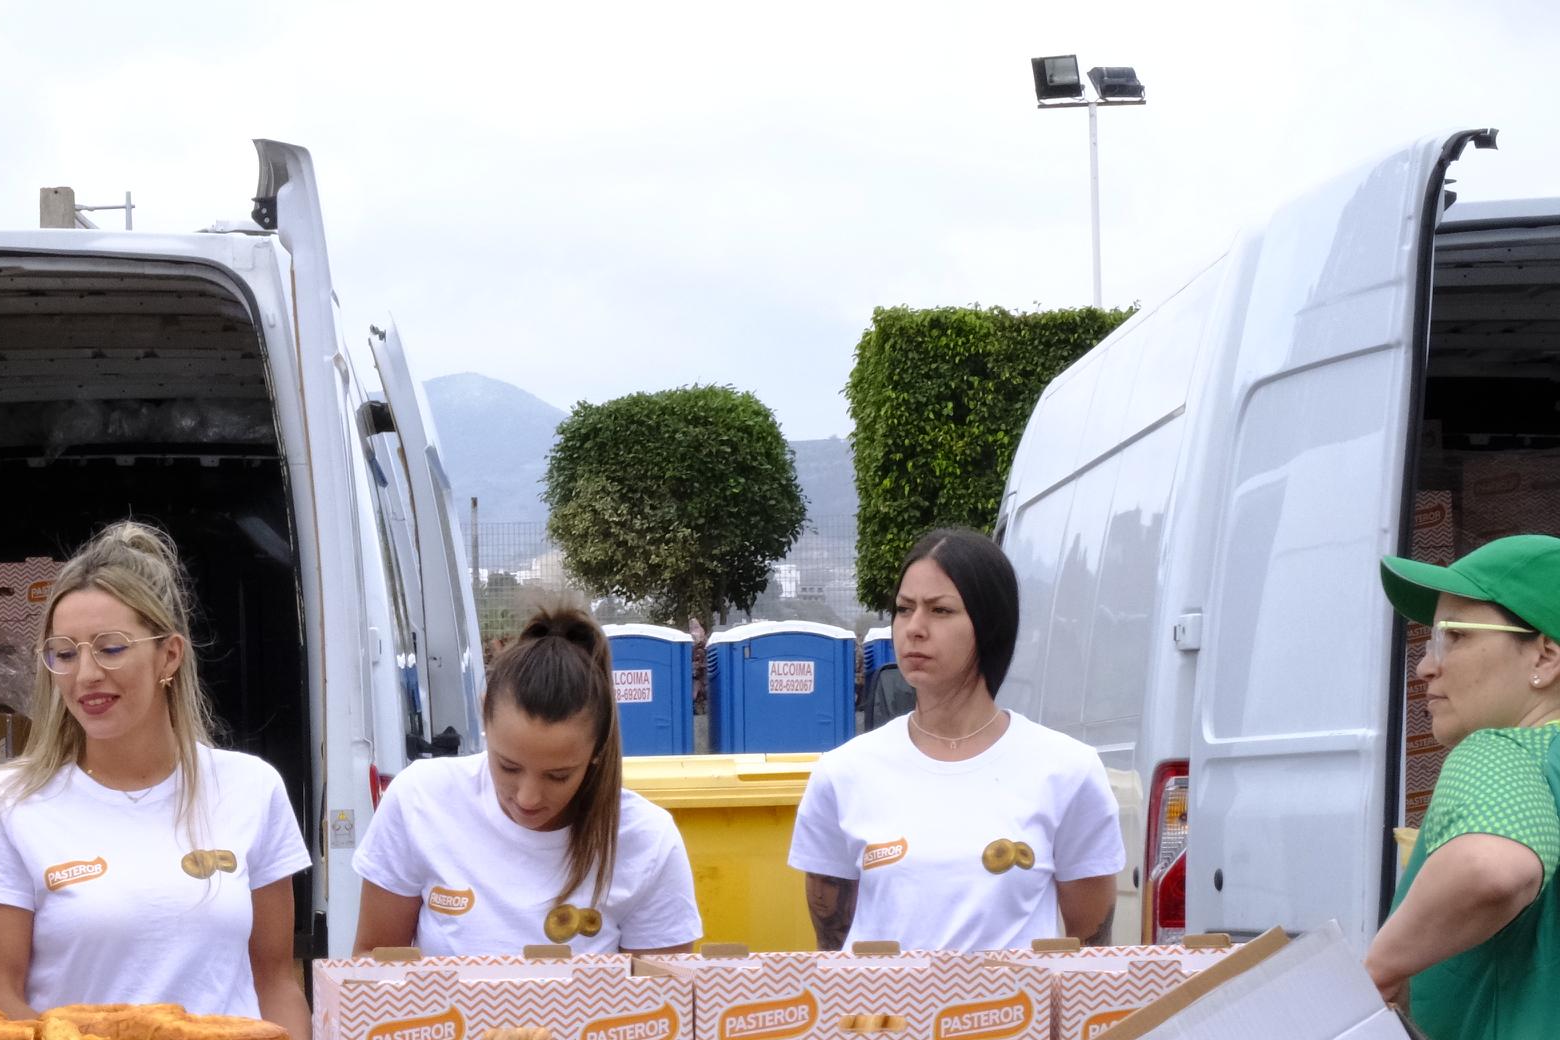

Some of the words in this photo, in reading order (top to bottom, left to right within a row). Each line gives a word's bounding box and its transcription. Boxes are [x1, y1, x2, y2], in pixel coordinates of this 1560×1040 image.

[770, 662, 812, 676] ALCOIMA
[614, 671, 650, 686] LCOIMA
[769, 678, 813, 692] 928-692067
[615, 687, 651, 701] 8-692067
[48, 863, 103, 887] PASTEROR
[725, 1001, 812, 1038] PASTEROR
[940, 1001, 1025, 1038] PASTEROR
